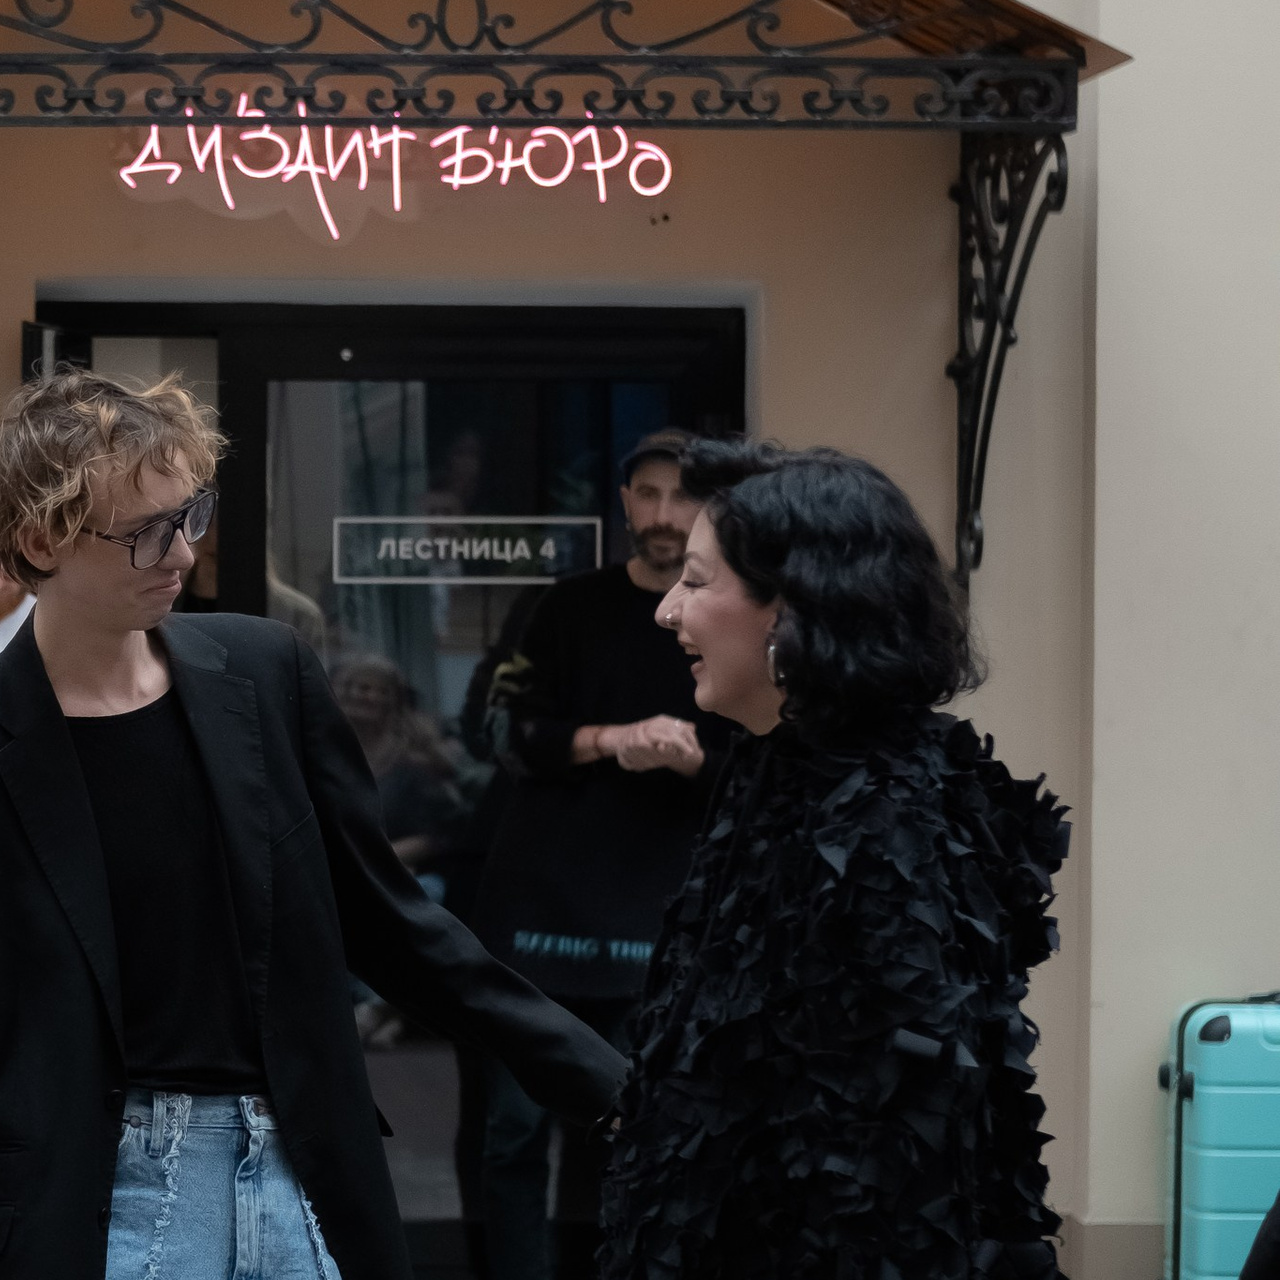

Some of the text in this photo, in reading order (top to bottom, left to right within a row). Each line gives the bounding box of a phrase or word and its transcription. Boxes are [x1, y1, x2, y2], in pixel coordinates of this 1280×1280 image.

[429, 110, 672, 203] БЮРО
[376, 537, 557, 563] ЛЕСТНИЦА 4
